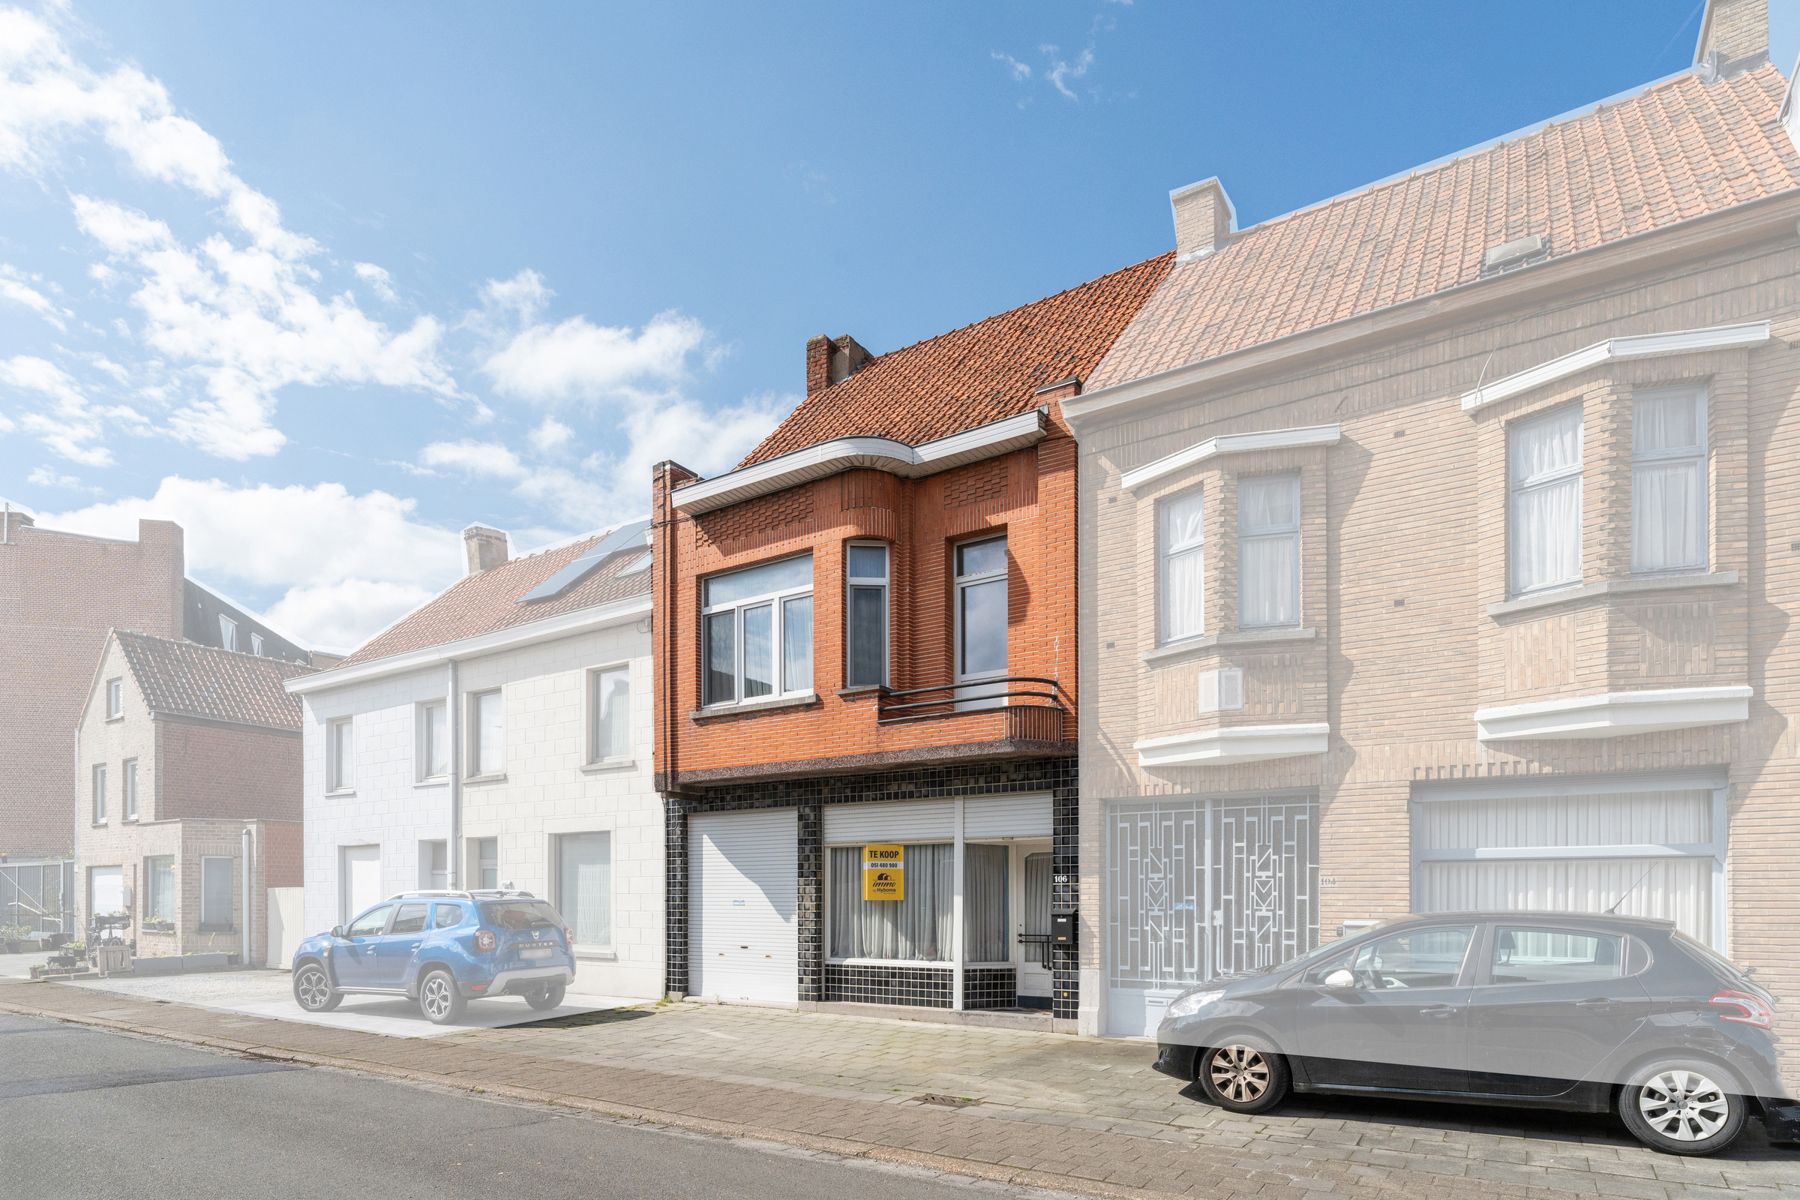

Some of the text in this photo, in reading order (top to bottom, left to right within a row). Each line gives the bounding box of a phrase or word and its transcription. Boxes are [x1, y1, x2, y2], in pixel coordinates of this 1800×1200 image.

[869, 850, 899, 858] TE KOOP
[1054, 875, 1068, 883] 106
